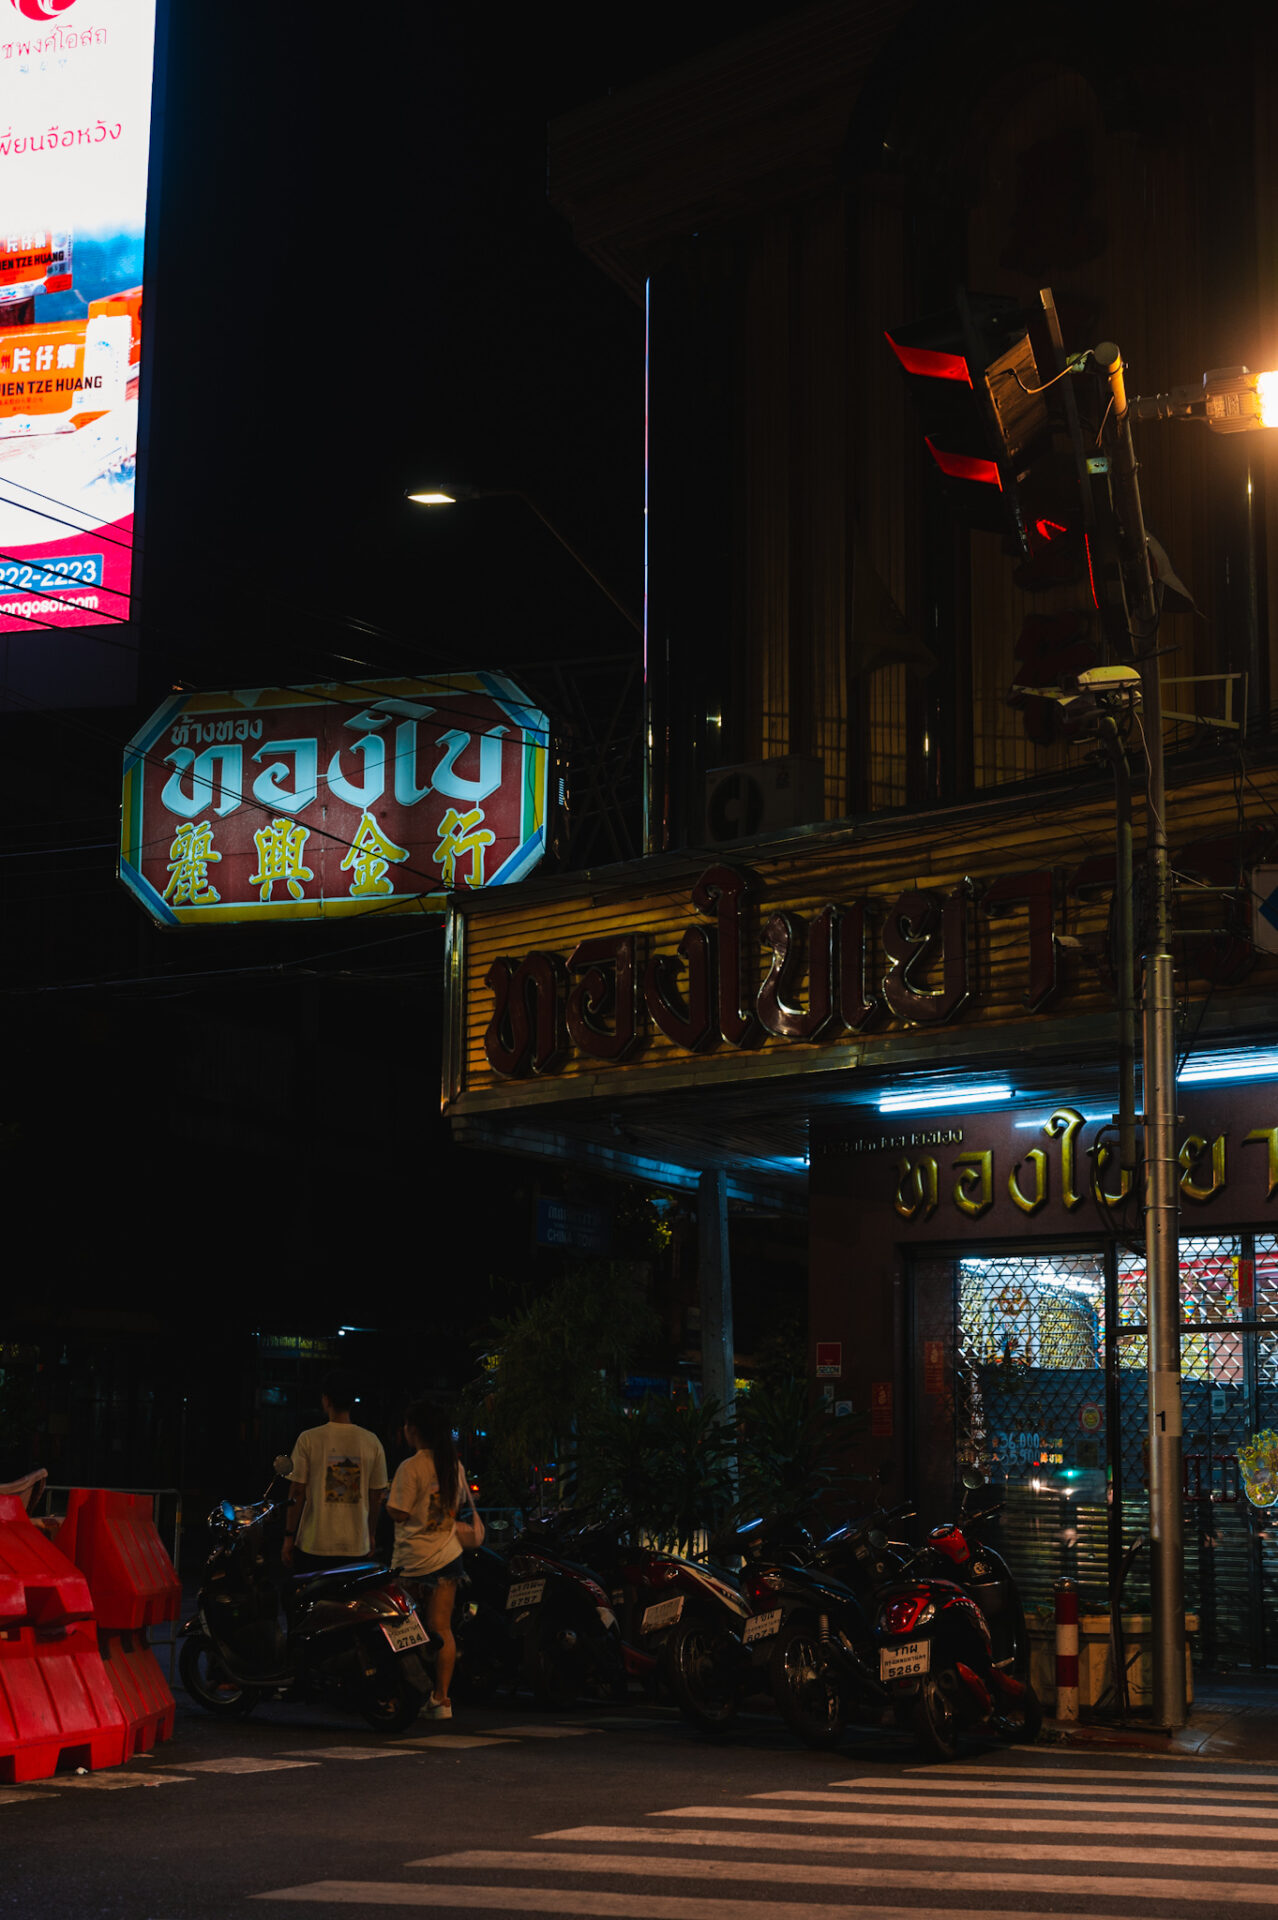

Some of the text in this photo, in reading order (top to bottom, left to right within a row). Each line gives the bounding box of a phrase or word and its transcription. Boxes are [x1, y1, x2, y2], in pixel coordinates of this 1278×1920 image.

[16, 256, 33, 269] TZE
[34, 250, 65, 265] HUANG
[0, 376, 103, 397] IEN TZE HUANG
[170, 715, 263, 746] ห้างทอง
[1156, 1411, 1166, 1432] 1
[888, 1663, 921, 1678] 5286
